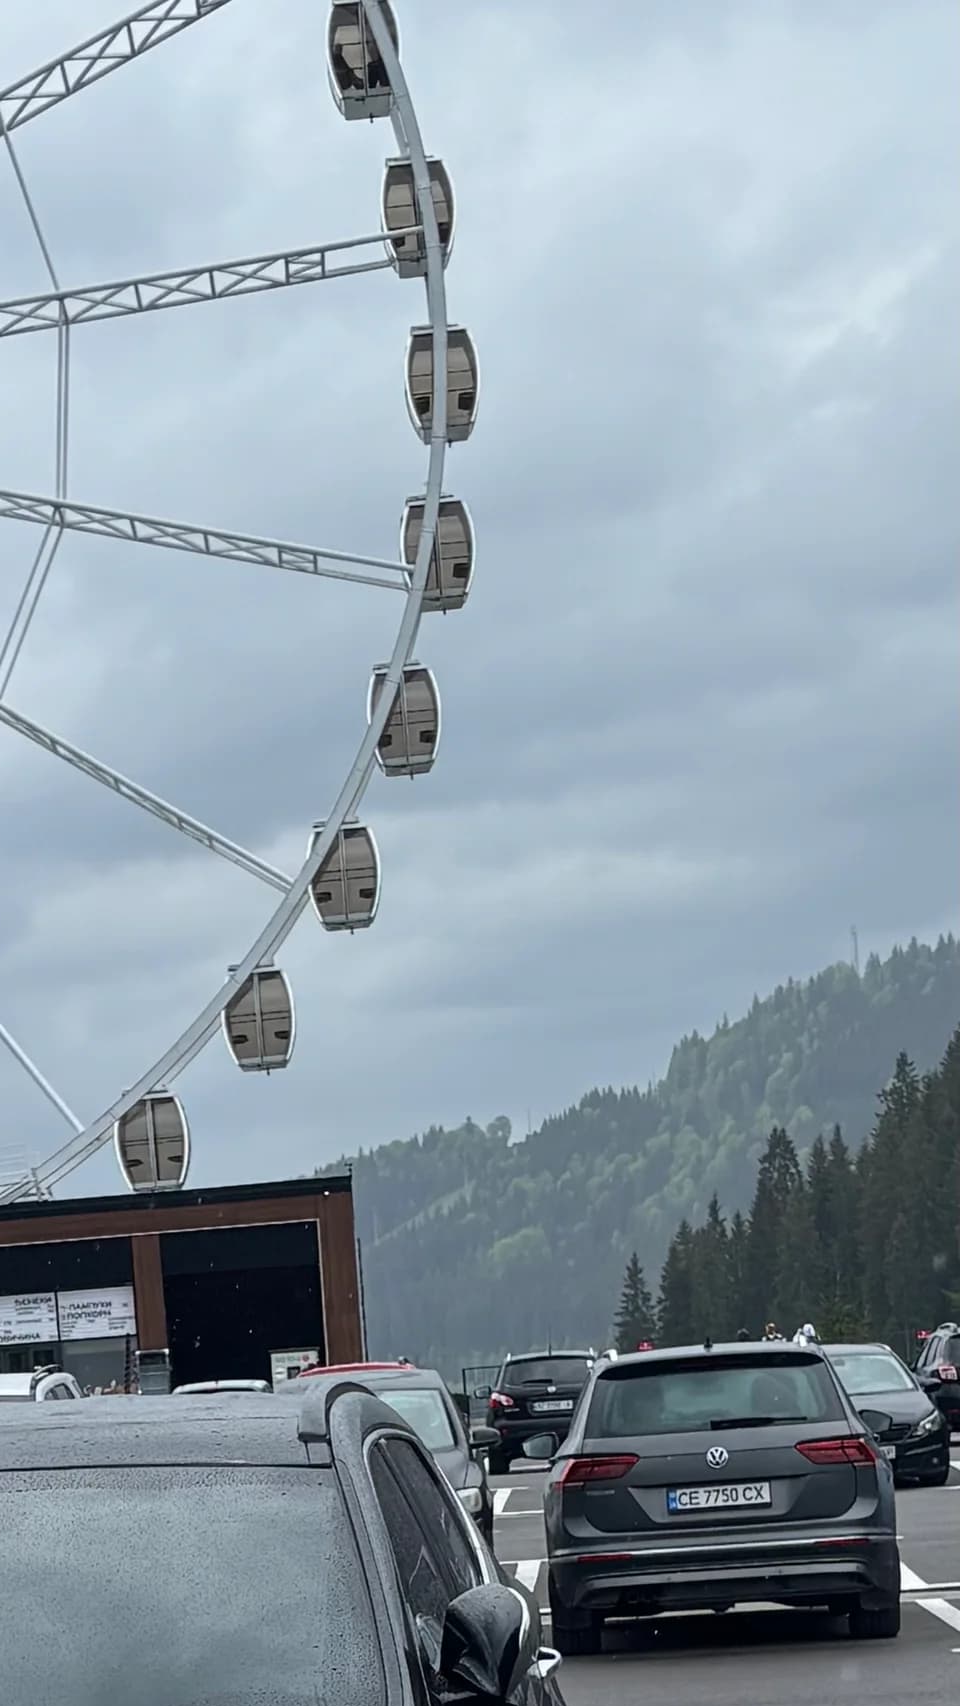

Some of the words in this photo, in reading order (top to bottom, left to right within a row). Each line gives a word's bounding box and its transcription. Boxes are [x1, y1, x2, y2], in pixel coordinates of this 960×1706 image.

[678, 1490, 700, 1506] CE
[703, 1487, 739, 1504] 7750
[742, 1485, 764, 1501] CX
